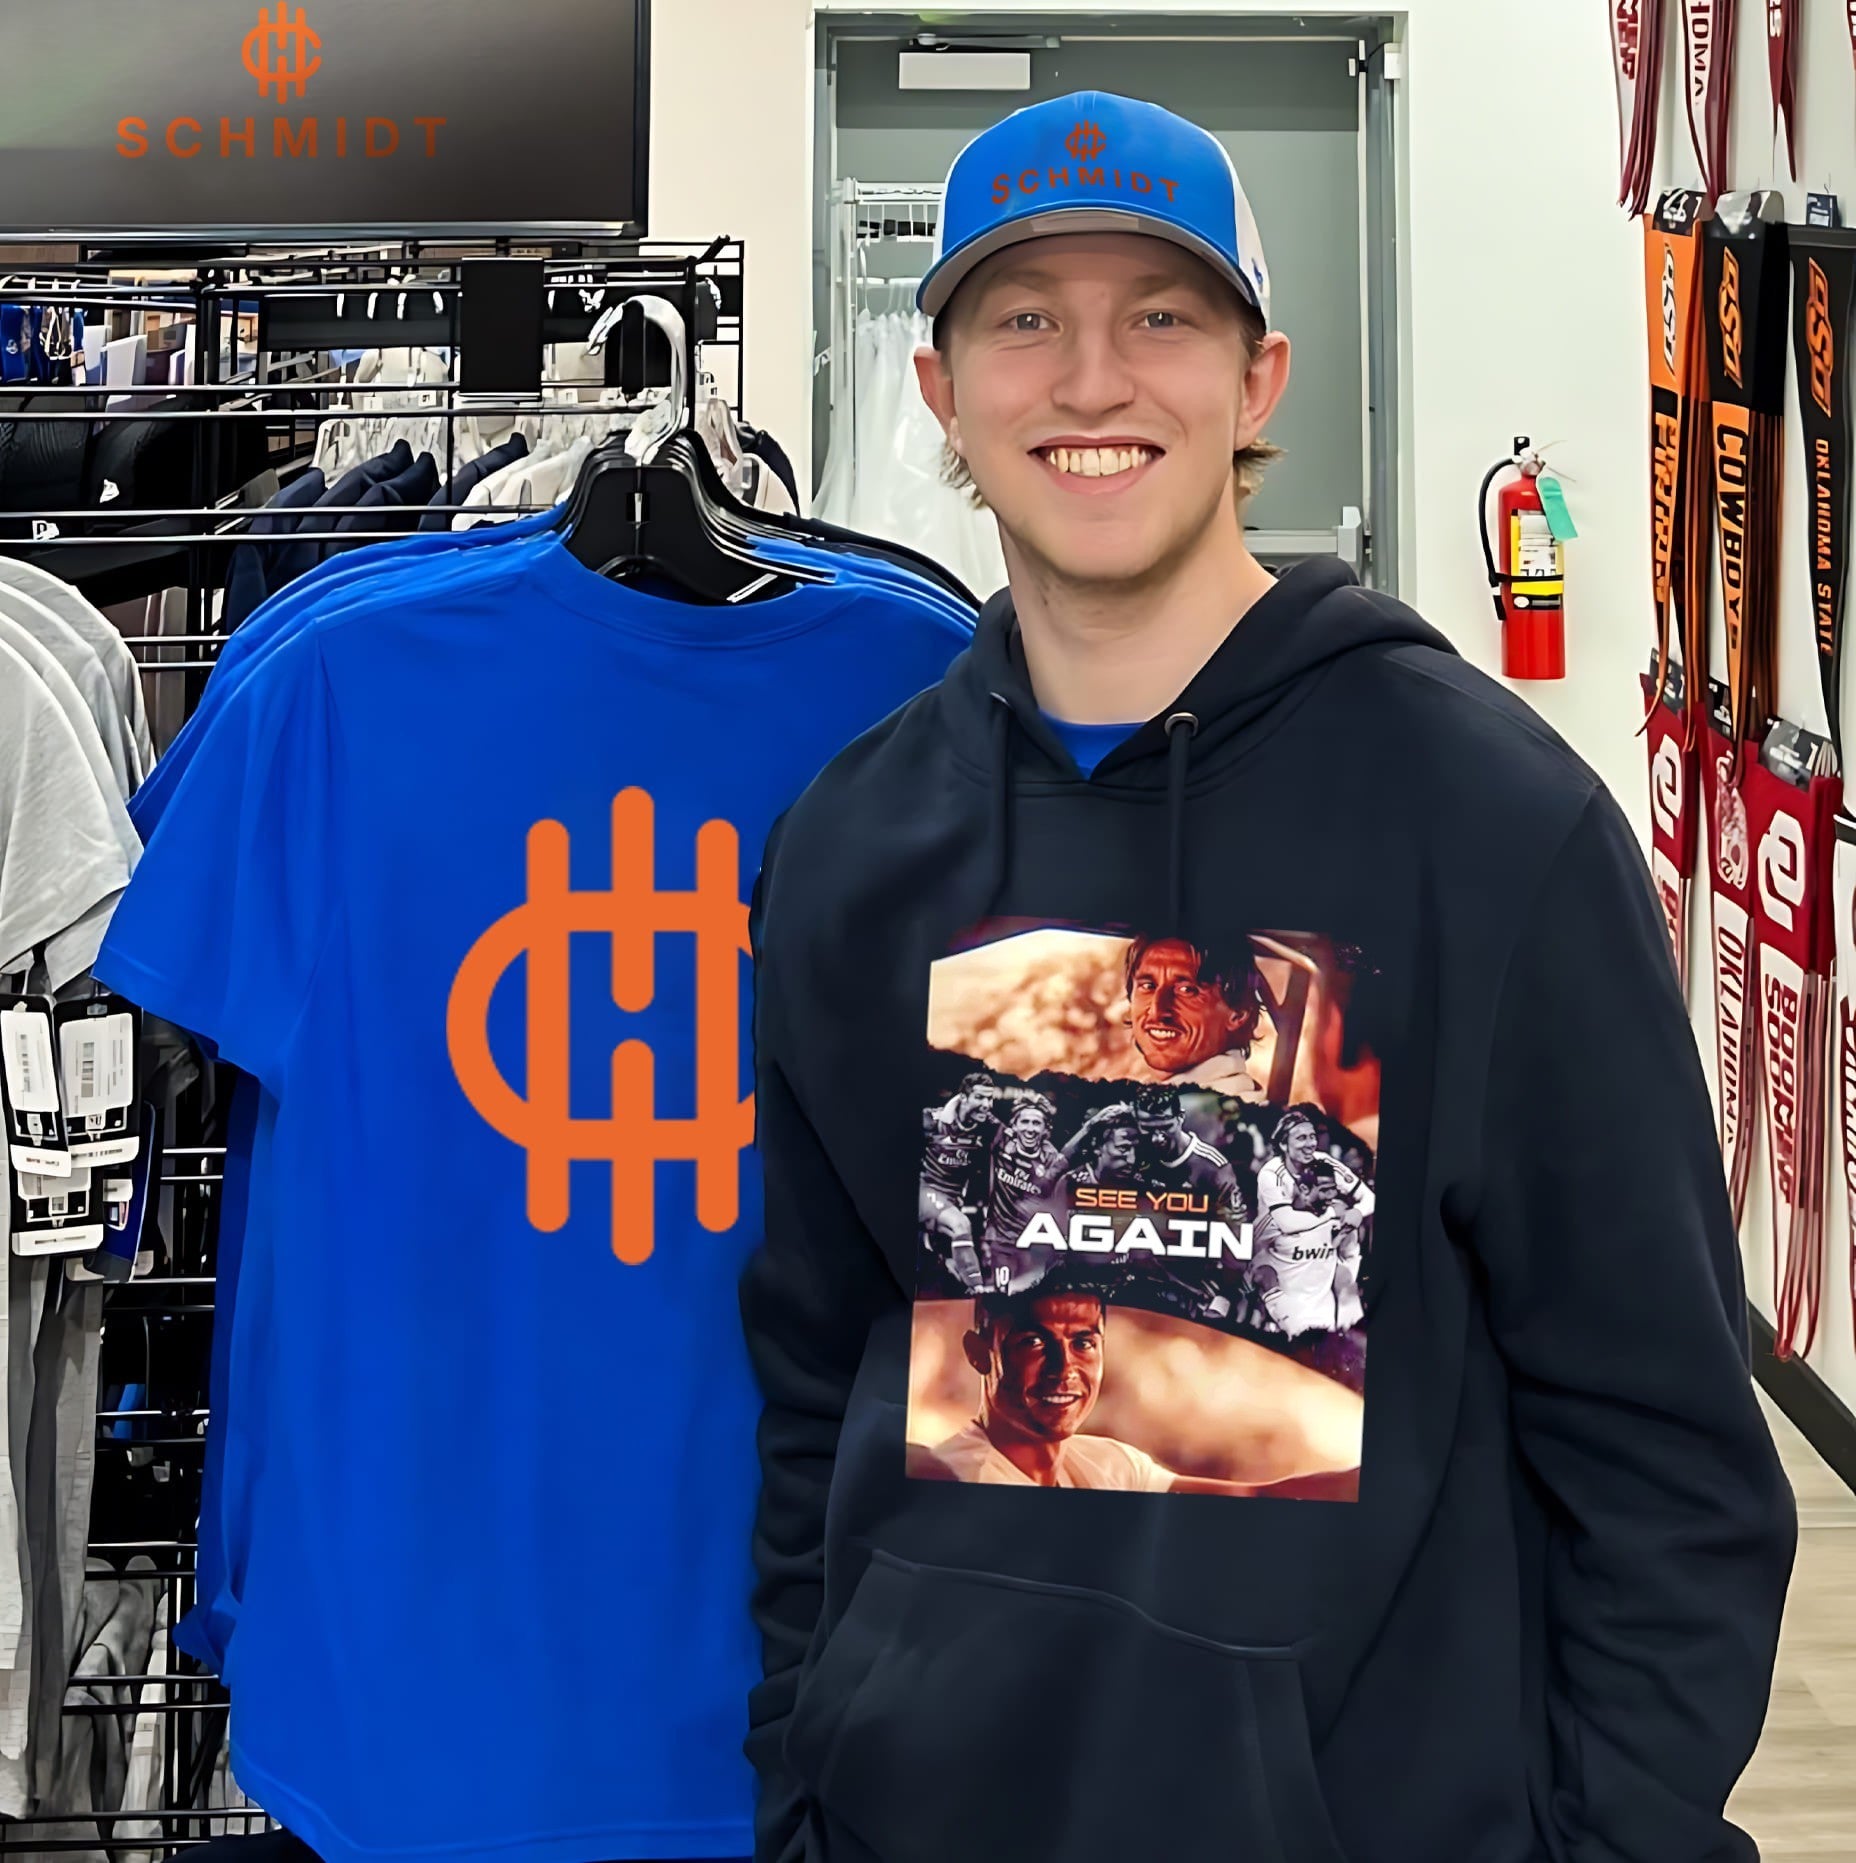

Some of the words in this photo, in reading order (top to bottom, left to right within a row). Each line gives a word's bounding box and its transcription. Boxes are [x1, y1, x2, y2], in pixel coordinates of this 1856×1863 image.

[115, 116, 448, 159] SCHMIDT
[991, 167, 1179, 205] SCHMIDT
[1815, 438, 1832, 571] OKLAHOMA
[1718, 925, 1746, 1145] OKLAHOMA
[1075, 1188, 1138, 1209] SEE
[1145, 1191, 1209, 1213] YOU
[1015, 1212, 1254, 1261] AGAIN
